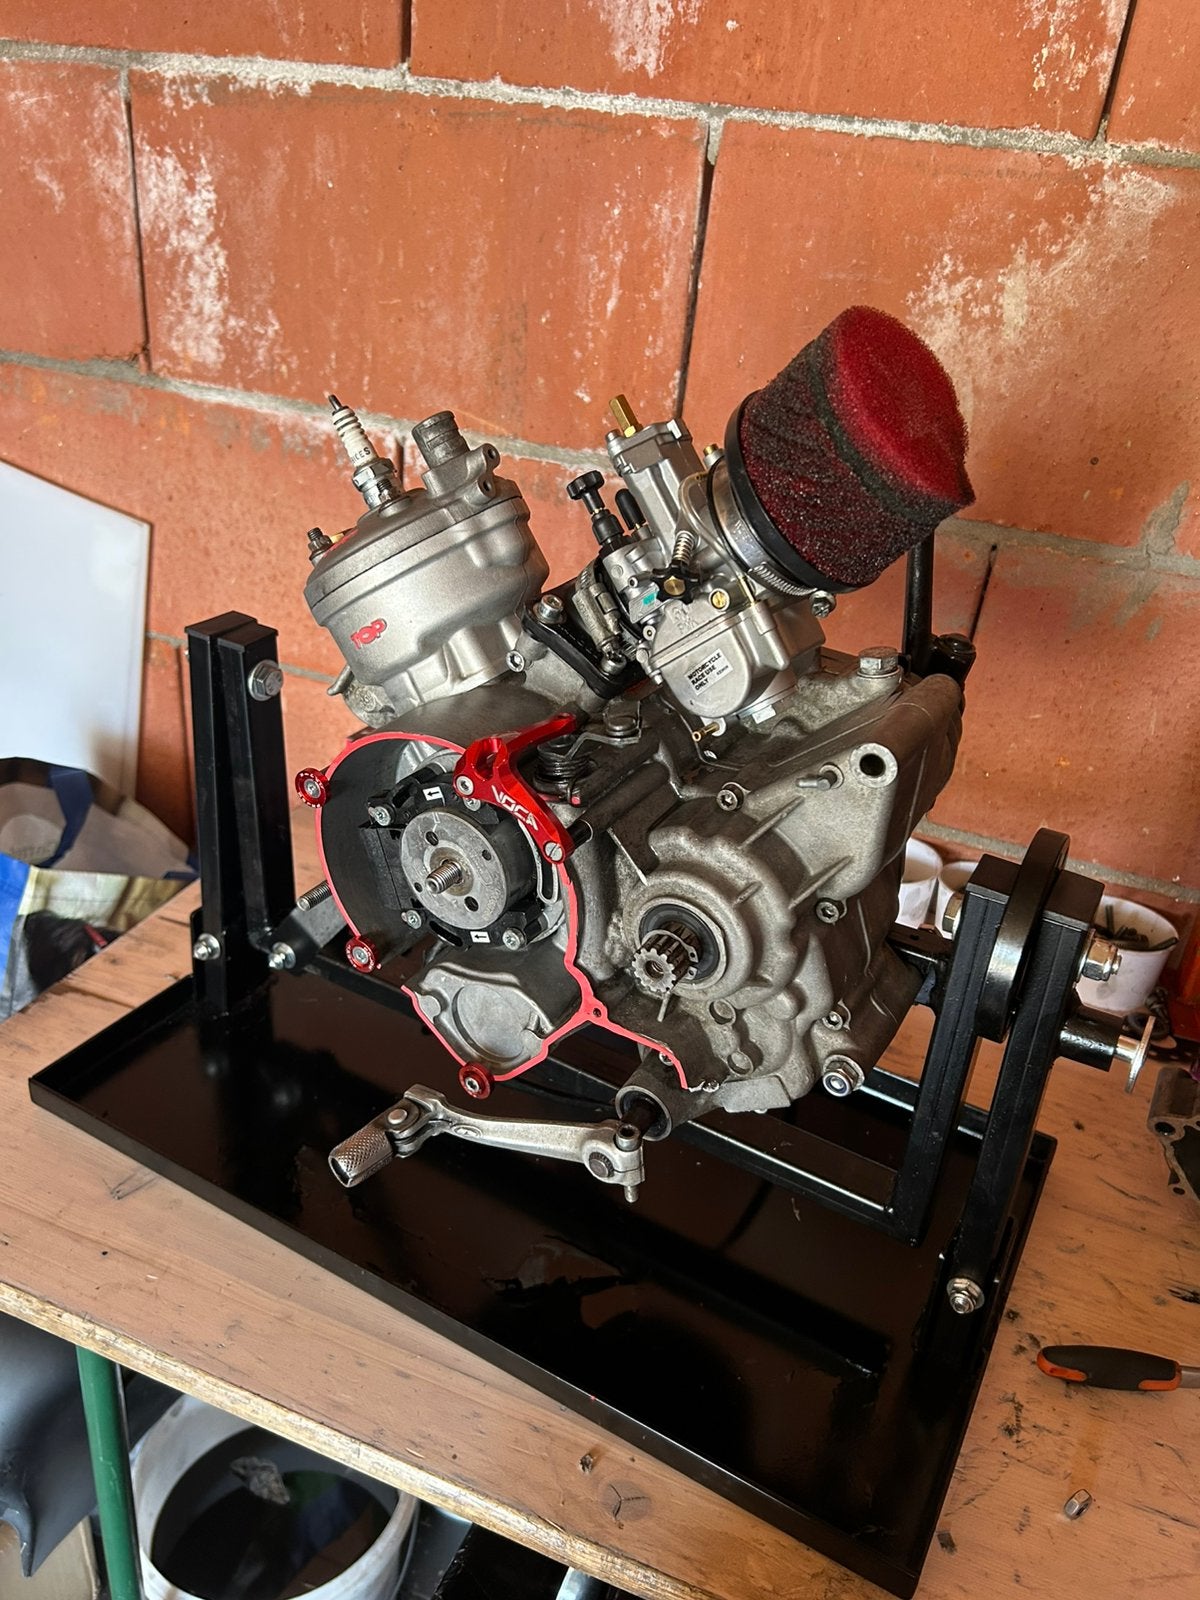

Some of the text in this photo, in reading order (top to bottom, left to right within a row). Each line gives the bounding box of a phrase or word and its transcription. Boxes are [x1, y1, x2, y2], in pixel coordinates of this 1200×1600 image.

[350, 618, 387, 650] TOP
[687, 652, 721, 680] MOTORCYCLE
[691, 672, 706, 686] RACE
[704, 664, 717, 676] USE
[694, 678, 709, 691] ONLY
[491, 784, 539, 831] VOCA
